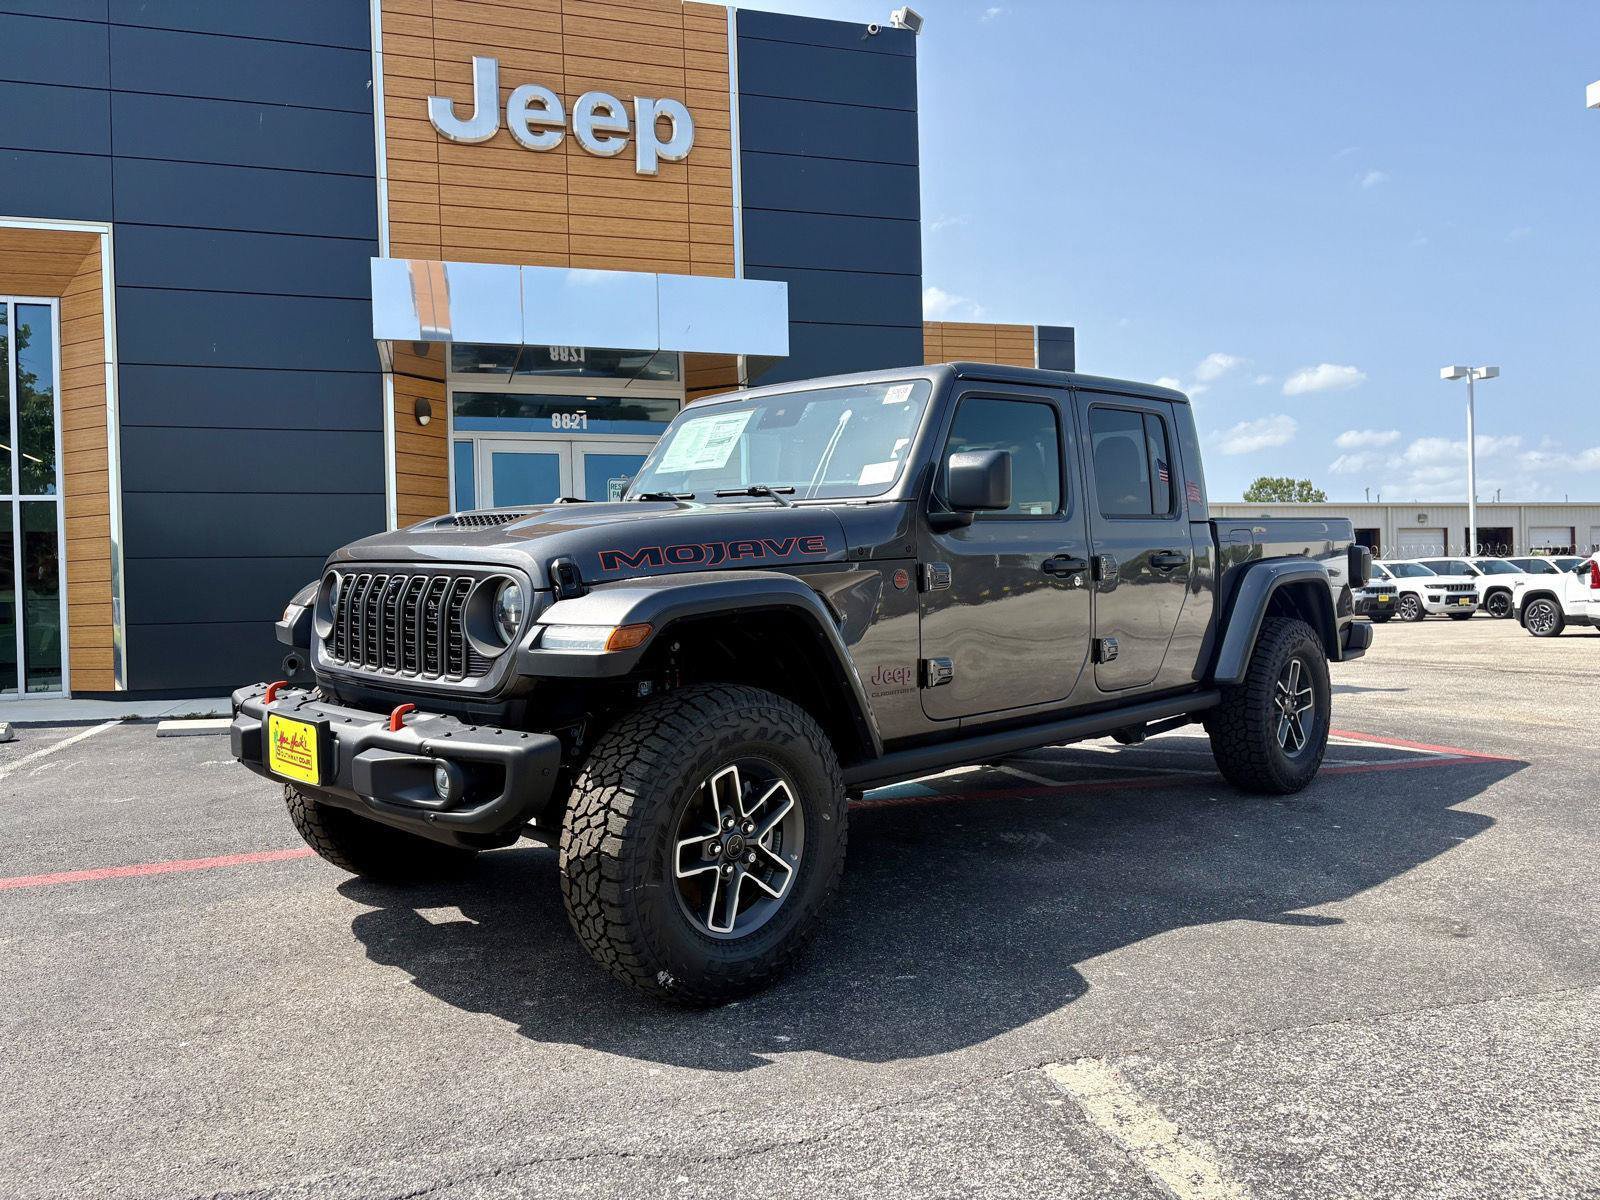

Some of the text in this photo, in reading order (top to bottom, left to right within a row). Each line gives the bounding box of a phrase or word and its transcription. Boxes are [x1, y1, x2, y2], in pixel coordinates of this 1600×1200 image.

[428, 56, 695, 176] Jeep
[551, 412, 588, 430] 8821
[598, 536, 827, 571] MOJAVE
[871, 664, 912, 686] Jeep
